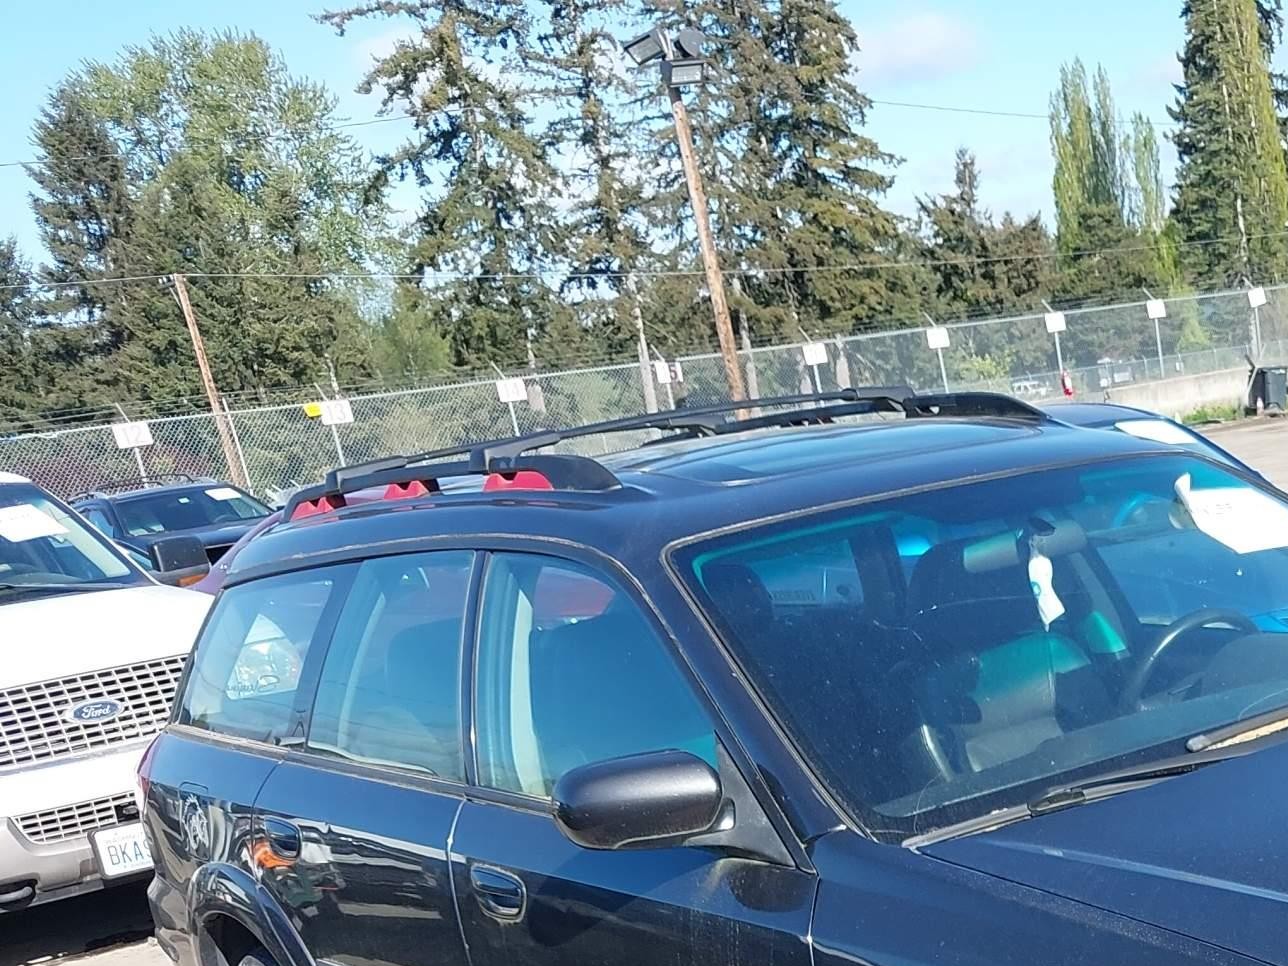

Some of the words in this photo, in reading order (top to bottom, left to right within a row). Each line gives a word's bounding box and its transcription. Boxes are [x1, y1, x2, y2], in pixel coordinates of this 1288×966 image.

[326, 403, 346, 421] 13
[121, 425, 149, 445] 12
[81, 704, 111, 719] Ford
